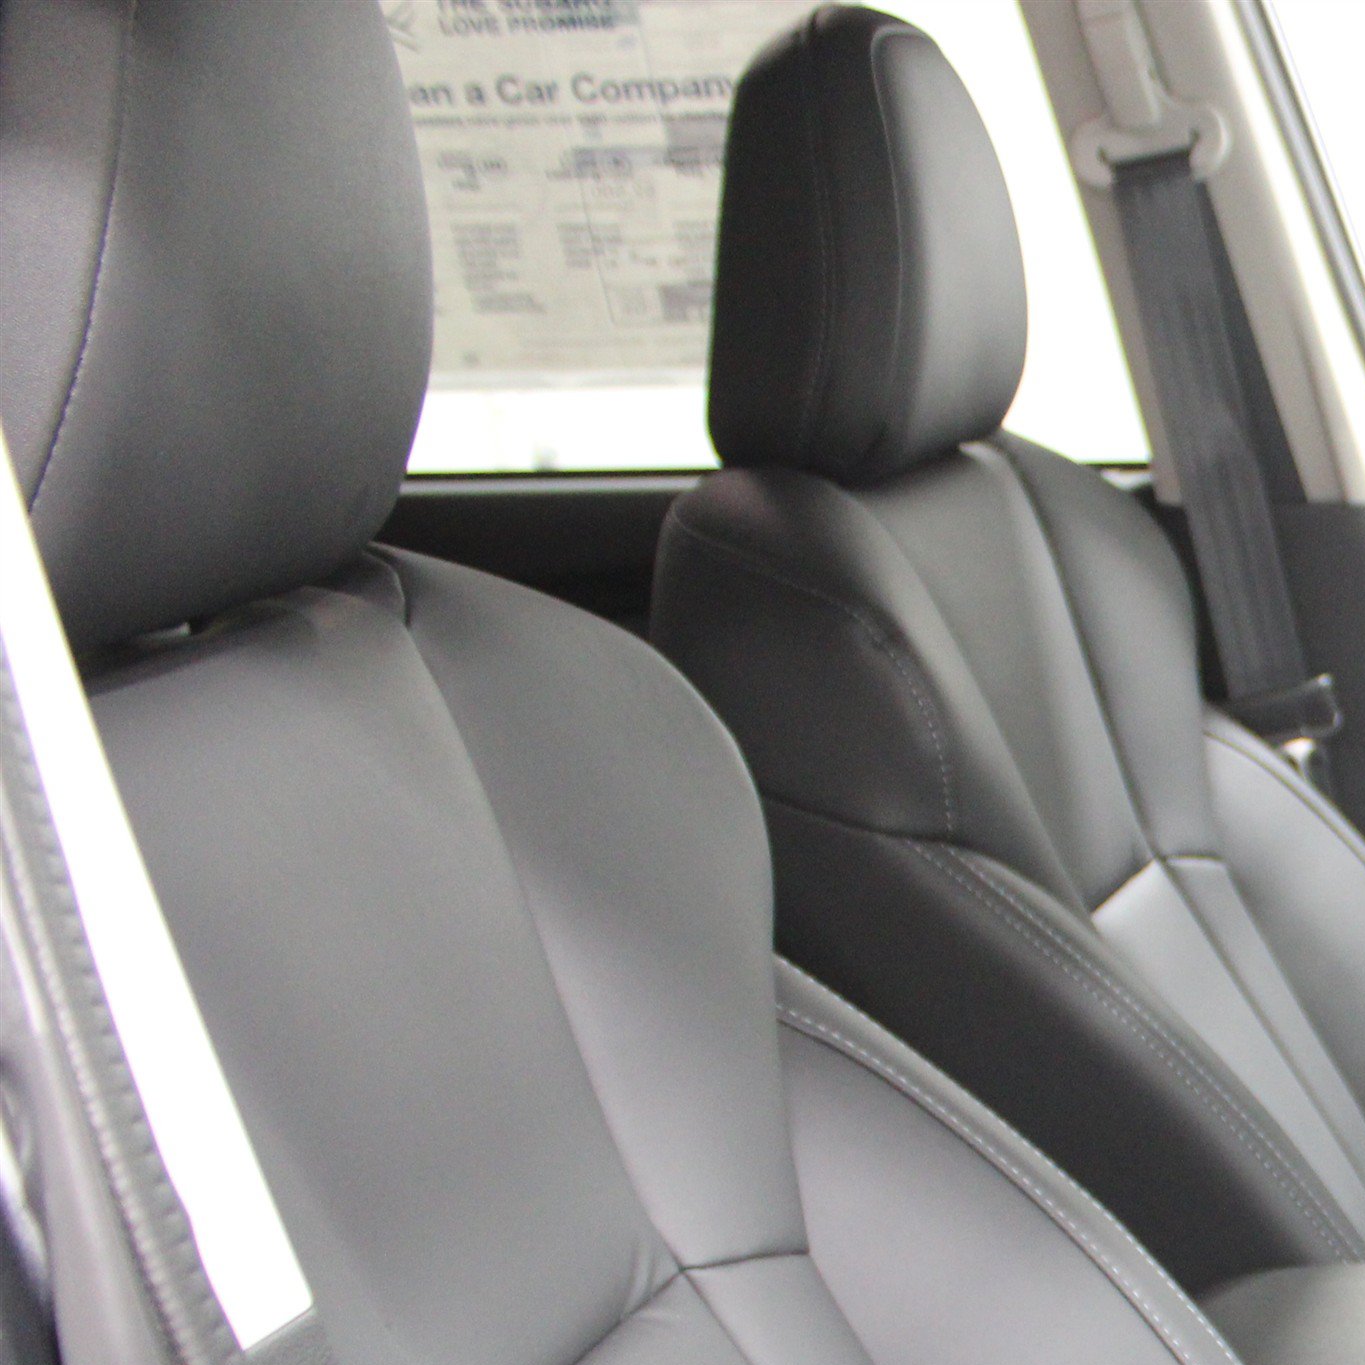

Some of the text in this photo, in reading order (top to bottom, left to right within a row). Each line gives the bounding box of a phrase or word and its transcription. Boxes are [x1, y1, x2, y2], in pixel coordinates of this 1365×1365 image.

[437, 17, 499, 36] LOVE
[463, 82, 487, 106] a
[496, 72, 559, 105] Car
